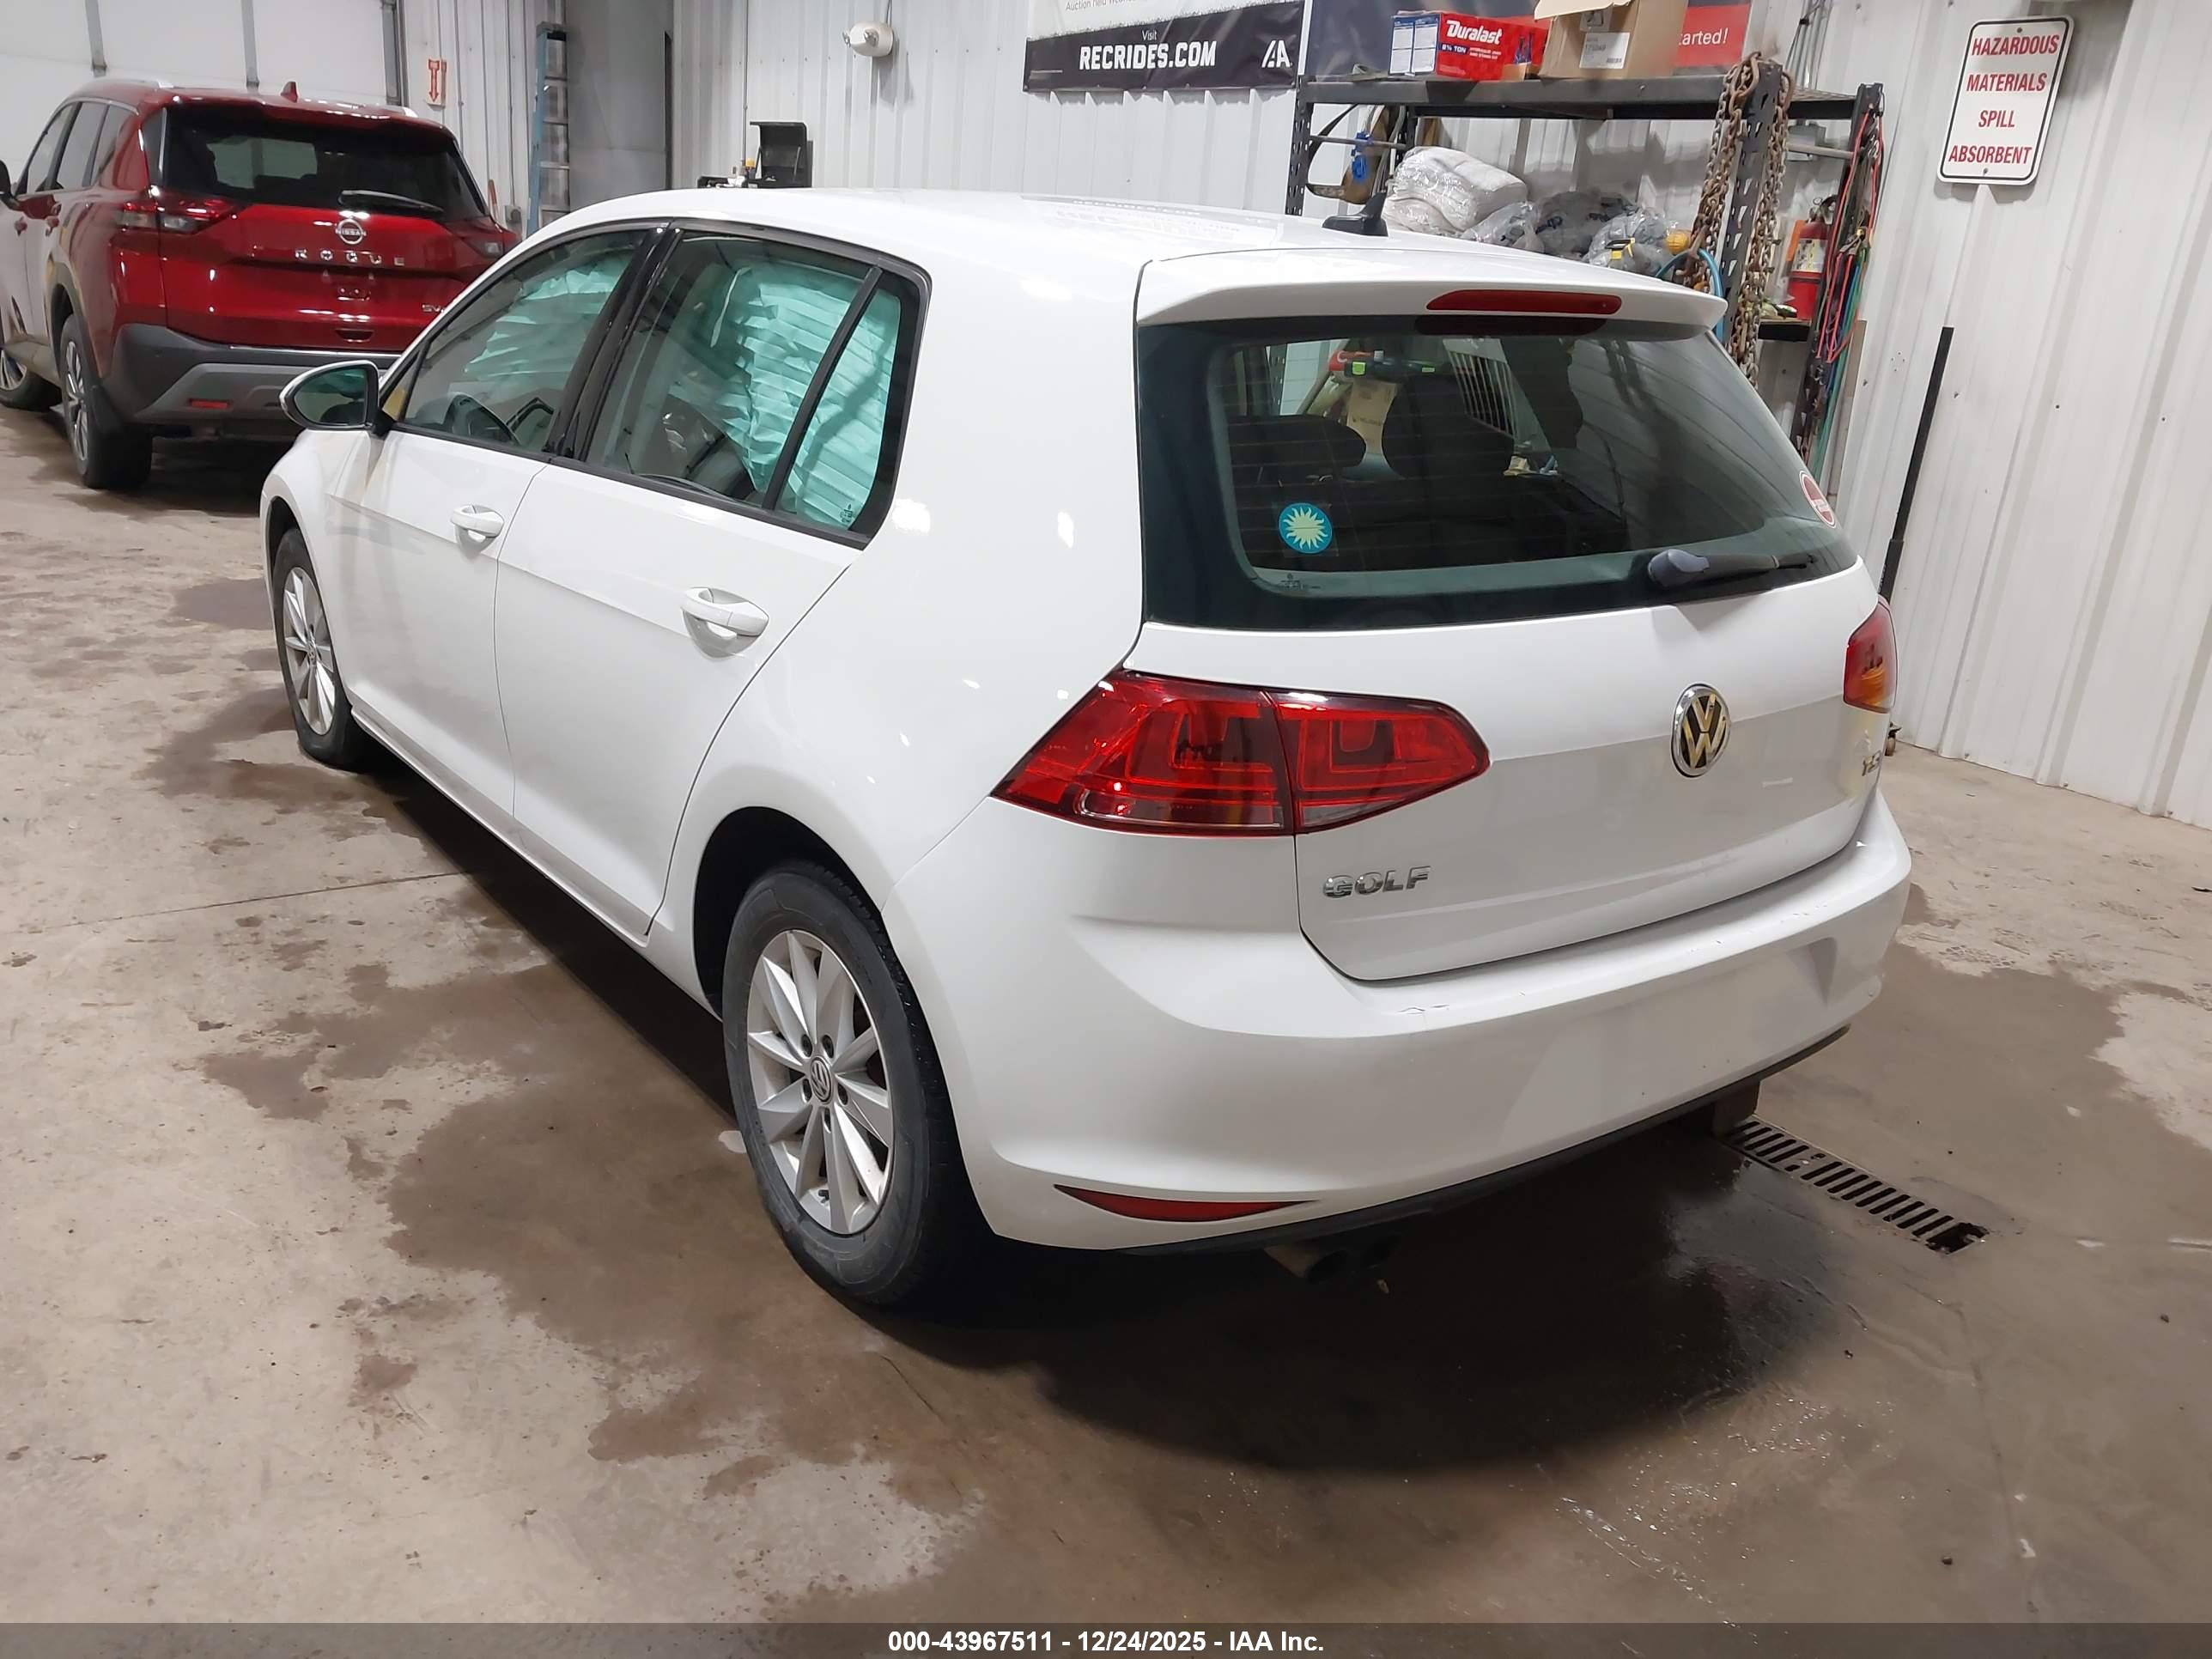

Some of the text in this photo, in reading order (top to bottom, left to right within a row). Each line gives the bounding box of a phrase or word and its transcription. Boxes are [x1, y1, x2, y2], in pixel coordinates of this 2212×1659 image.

[1142, 29, 1157, 40] Visit
[1446, 19, 1503, 45] Duralast
[1679, 27, 1729, 45] arted!
[1972, 34, 2060, 56] HAZARDOUS
[1079, 41, 1216, 70] RECRIDES.COM
[1966, 72, 2047, 92] MATERIALS
[1978, 110, 2015, 128] SPILL
[1948, 145, 2033, 164] ABSORBENT
[295, 248, 405, 266] ROGUE
[1322, 866, 1431, 898] GOLF
